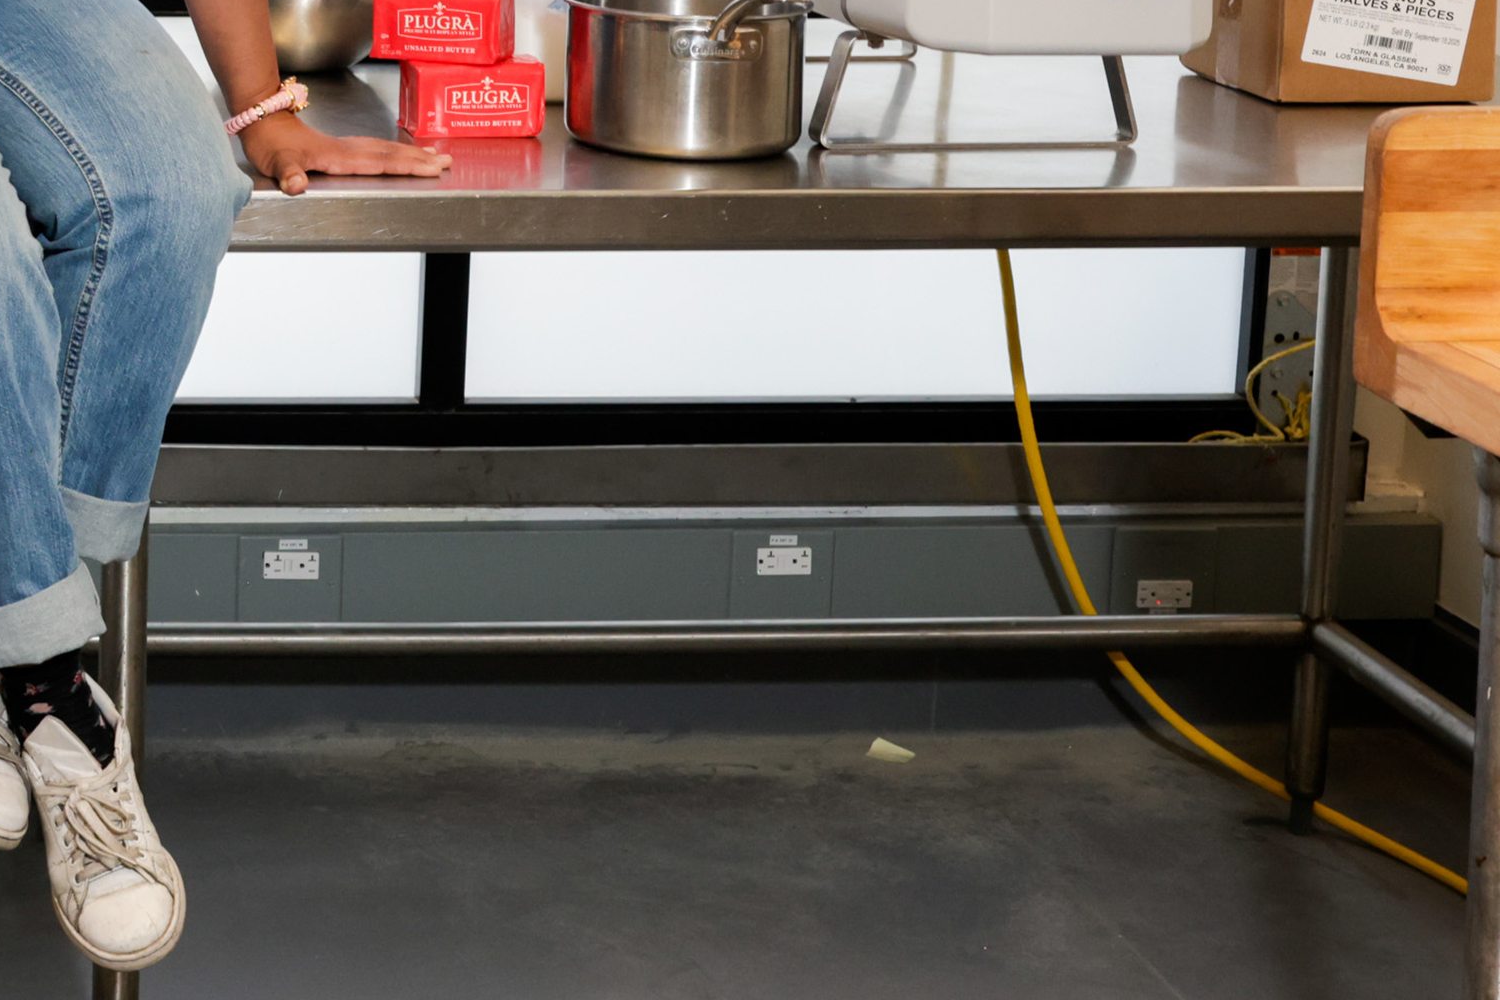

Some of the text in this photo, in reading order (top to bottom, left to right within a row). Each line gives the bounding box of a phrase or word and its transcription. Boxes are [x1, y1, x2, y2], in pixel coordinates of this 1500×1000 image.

[1392, 2, 1402, 13] &
[1406, 5, 1455, 21] PIECES
[404, 13, 475, 30] PLUGRÀ
[1391, 27, 1403, 36] Sell
[1404, 29, 1413, 39] By
[404, 44, 444, 53] UNSALTED
[445, 46, 476, 54] BUTTER
[1350, 47, 1371, 56] TORN
[1380, 53, 1417, 64] GLASSER
[1335, 52, 1352, 60] LOS
[1406, 64, 1428, 73] 90021
[452, 86, 523, 104] PLUGRÀ
